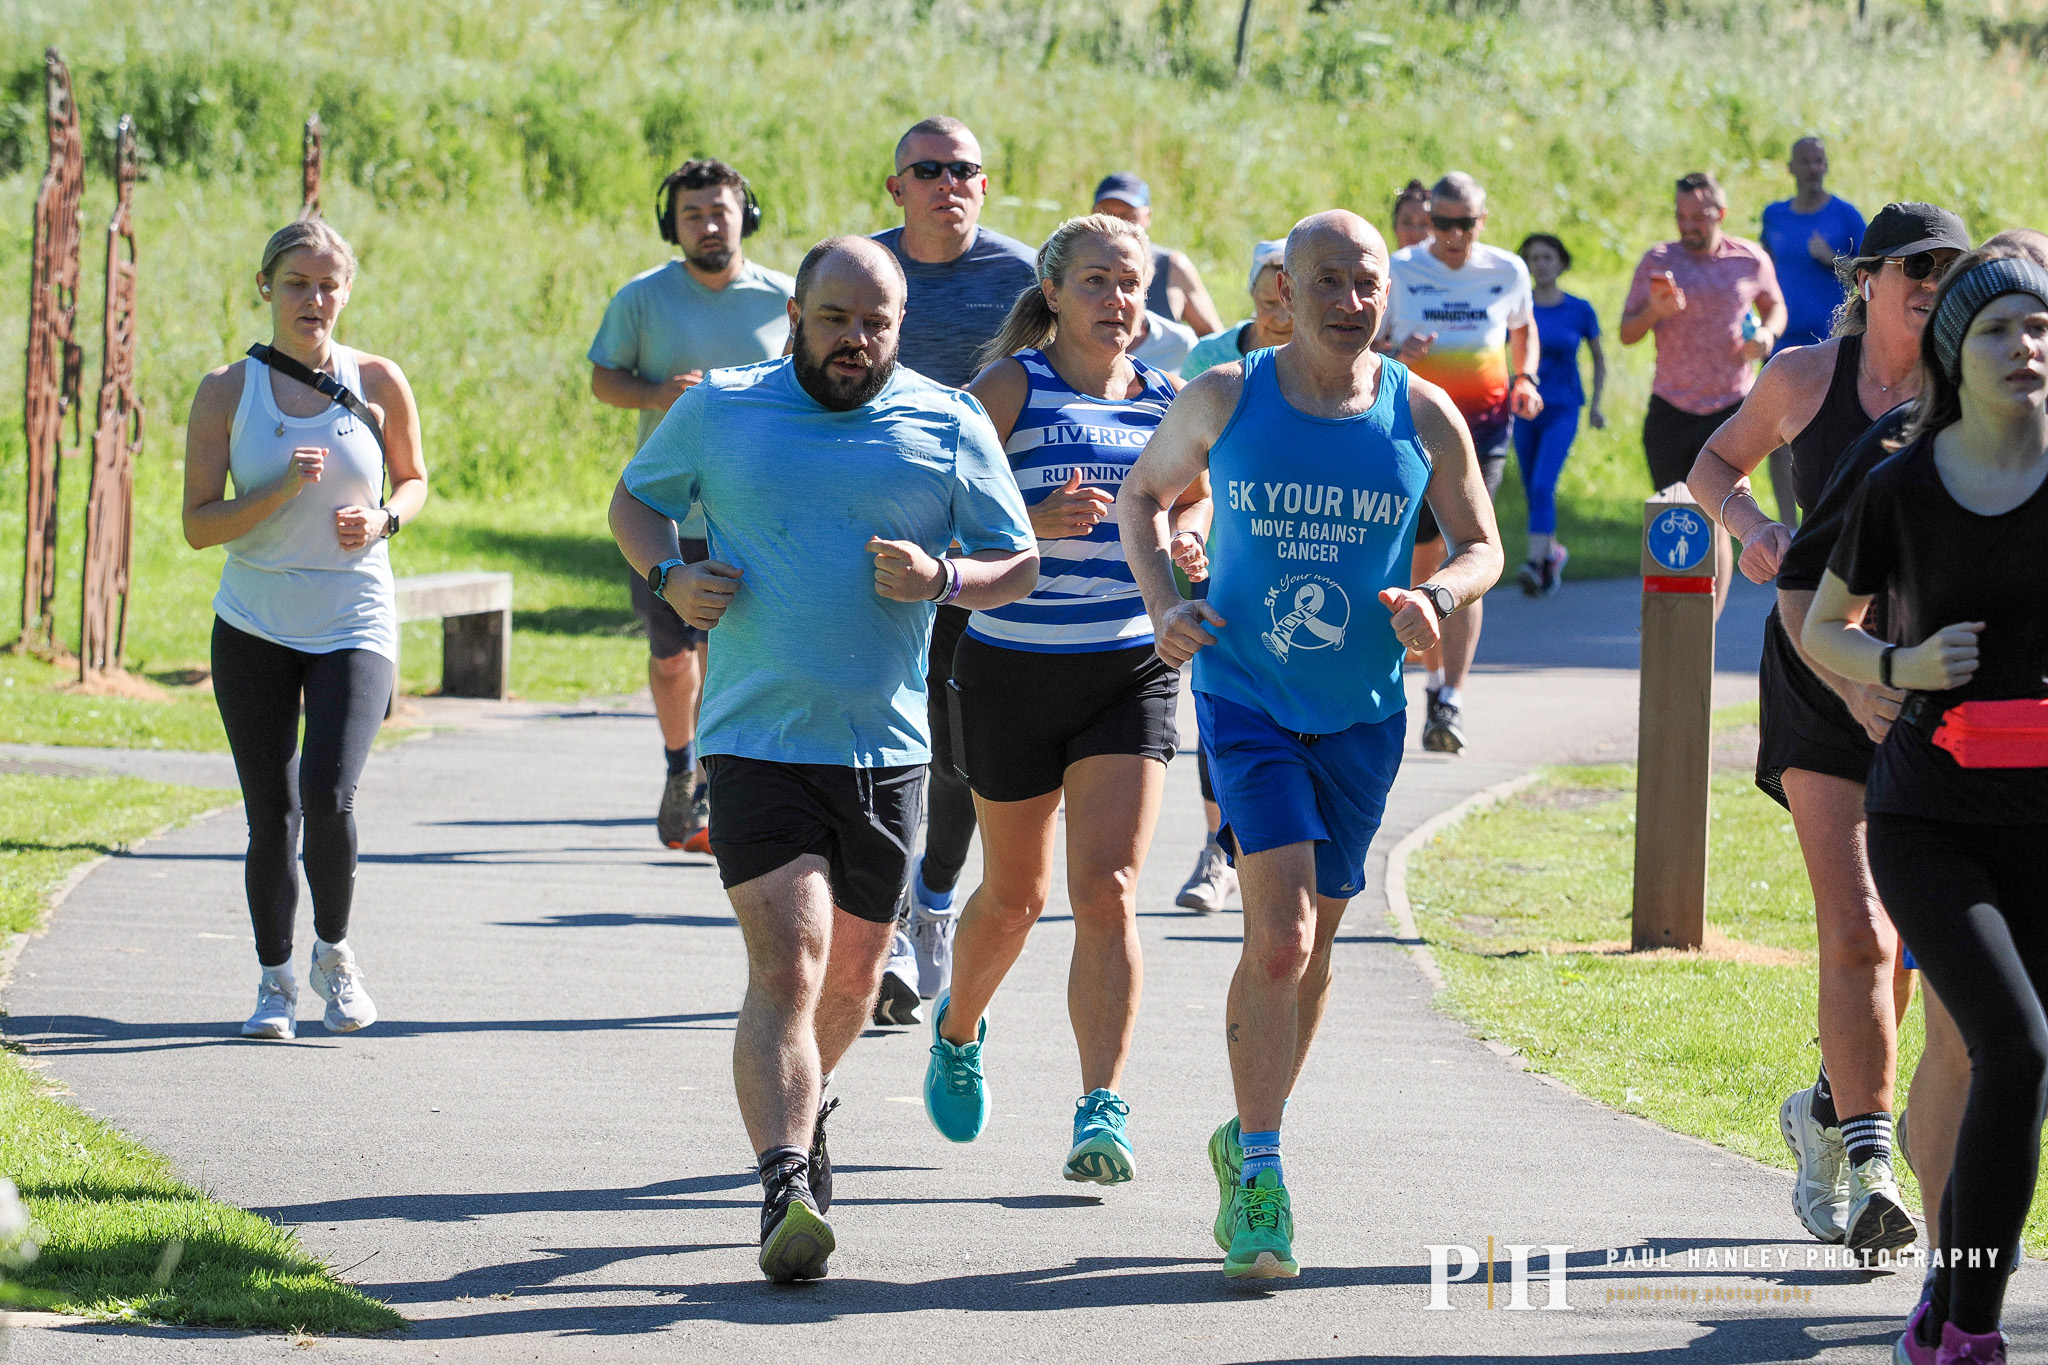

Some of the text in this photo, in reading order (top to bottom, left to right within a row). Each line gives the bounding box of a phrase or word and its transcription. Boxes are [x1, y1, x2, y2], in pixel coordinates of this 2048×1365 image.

[1043, 426, 1153, 446] LIVERPO
[1228, 480, 1410, 526] 5K YOUR WAY
[1251, 519, 1367, 545] MOVE AGAINST
[1277, 541, 1339, 563] CANCER
[1264, 573, 1339, 608] 5K Your way
[1272, 605, 1318, 647] MOVE
